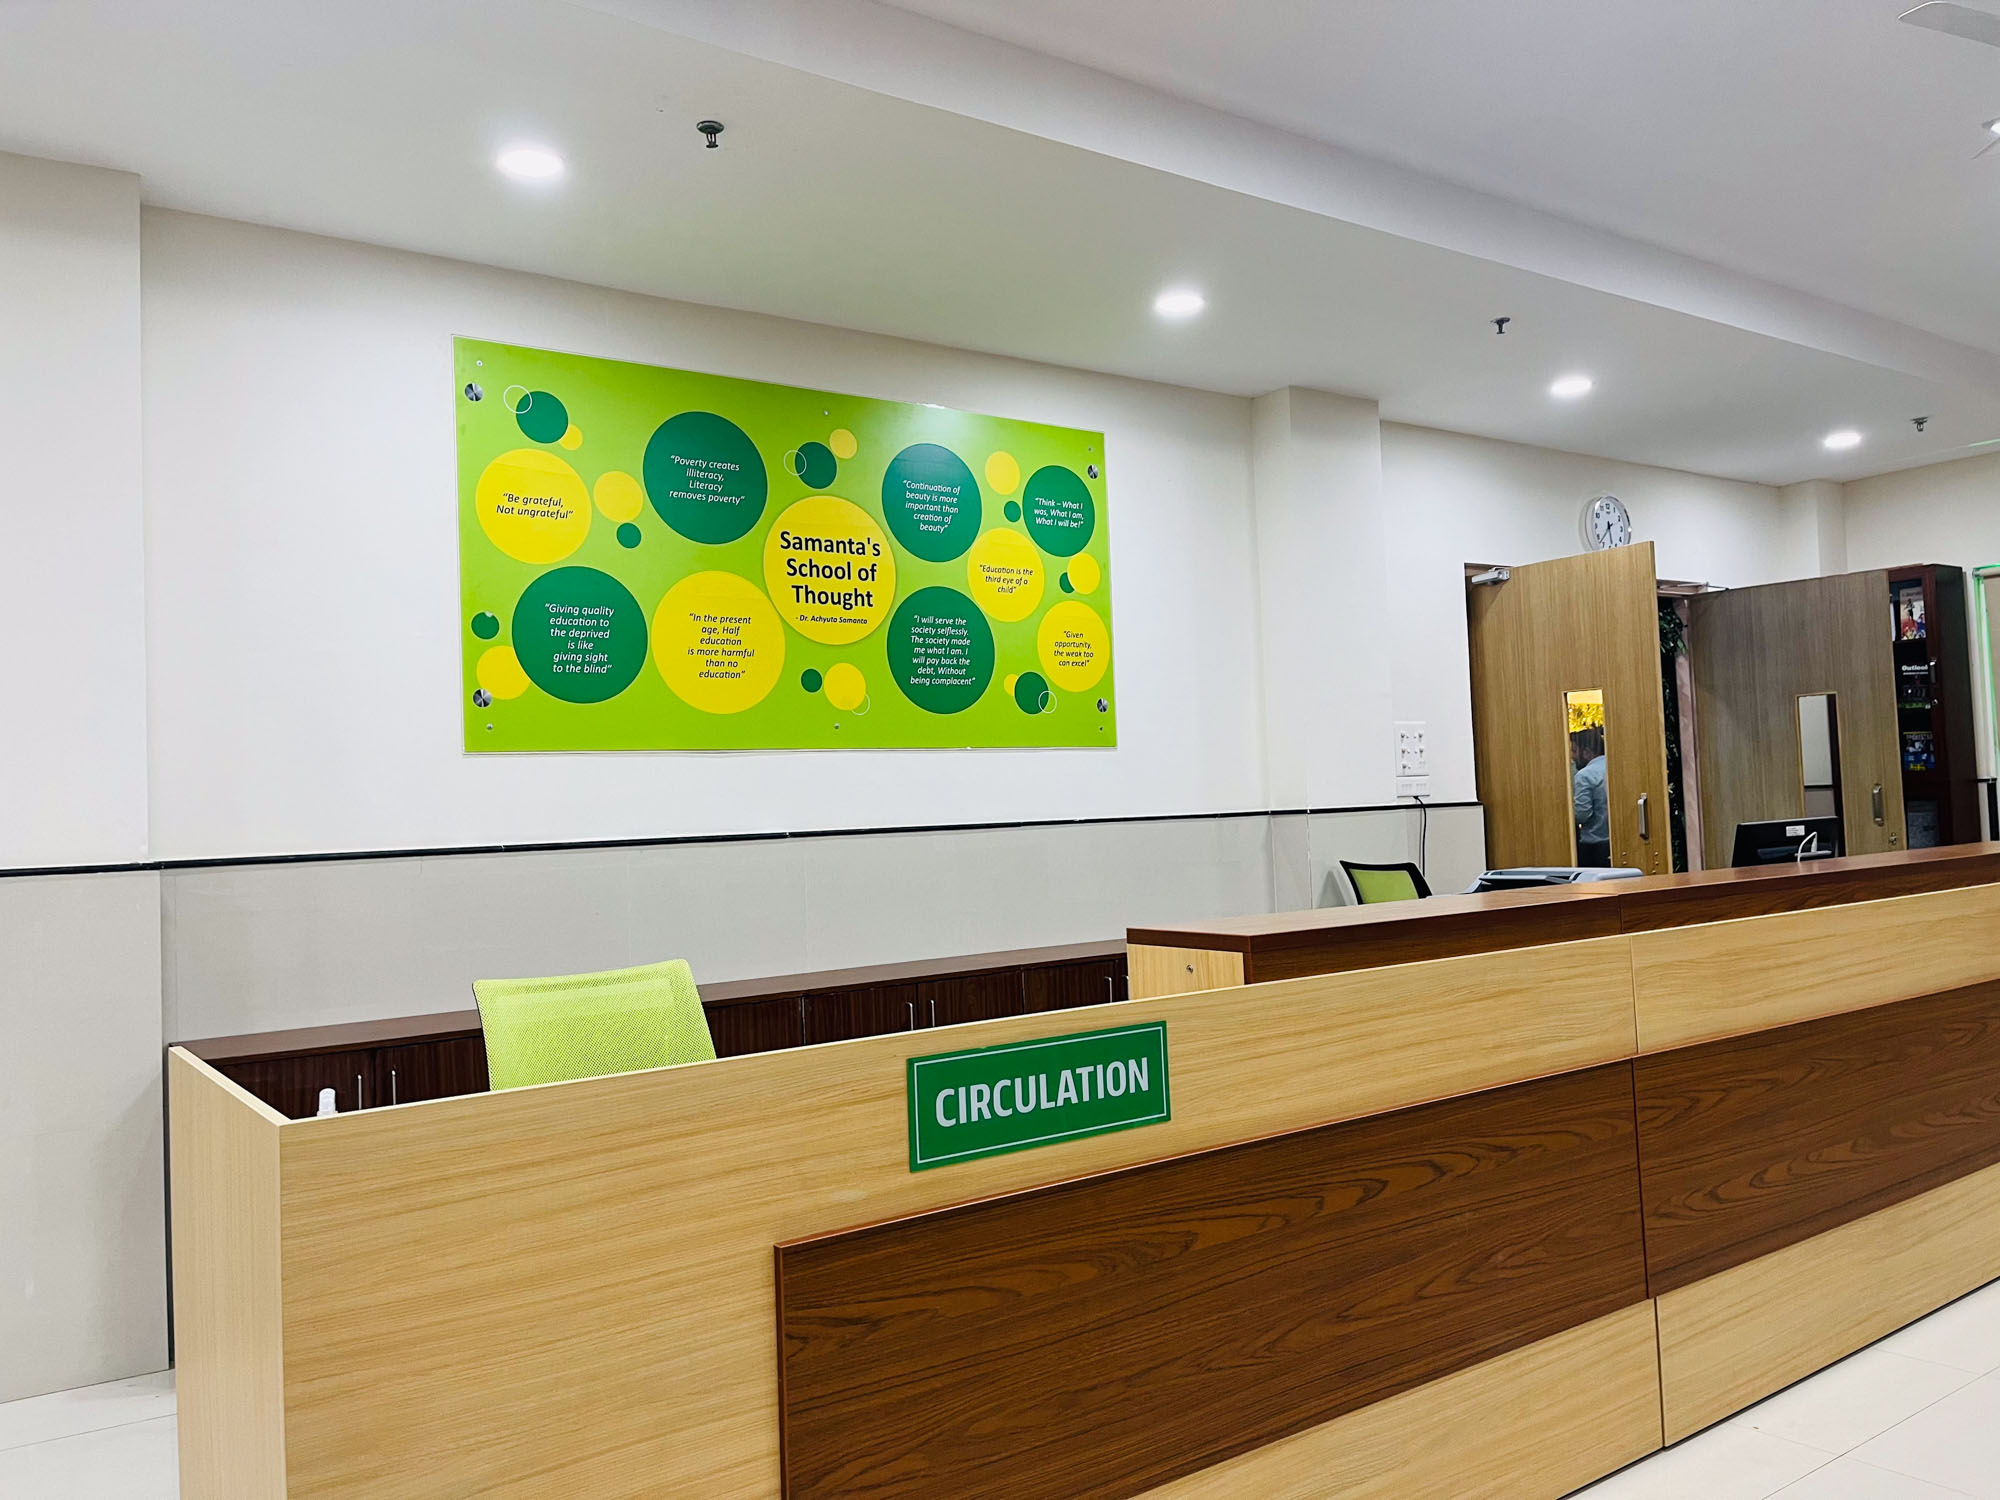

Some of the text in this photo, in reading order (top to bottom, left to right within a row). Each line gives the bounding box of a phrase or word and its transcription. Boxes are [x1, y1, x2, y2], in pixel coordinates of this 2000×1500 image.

[671, 455, 740, 471] “Poverty creates
[686, 469, 724, 481] illiteracy,
[689, 480, 722, 492] Literacy
[903, 480, 960, 495] “Continuation of
[503, 493, 564, 508] “Be grateful,
[670, 491, 745, 505] removes poverty”
[906, 491, 930, 502] beauty
[940, 496, 958, 504] more
[906, 501, 958, 513] important than
[1035, 498, 1056, 506] “Think
[1062, 501, 1079, 509] What
[496, 505, 573, 520] Not ungrateful”
[1034, 509, 1048, 517] was,
[1050, 509, 1067, 517] What
[913, 513, 952, 524] creation of
[1036, 517, 1053, 525] What
[920, 523, 948, 533] beauty”
[780, 531, 881, 556] Samanta's
[787, 558, 877, 581] School of
[980, 565, 1014, 574] “Education
[1016, 577, 1022, 586] of
[792, 585, 873, 610] Thought
[545, 604, 614, 617] “Giving quality
[550, 616, 609, 627] education to
[689, 613, 701, 621] “In
[704, 614, 717, 622] the
[914, 615, 920, 623] “I
[550, 628, 610, 639] the deprived
[702, 626, 740, 636] age, Half
[911, 626, 968, 636] society selflessly.
[568, 640, 594, 650] is like
[700, 637, 742, 645] education
[925, 637, 949, 646] society
[554, 652, 608, 663] giving sight
[722, 648, 754, 658] harmful
[553, 664, 612, 673] to the blind”
[706, 659, 725, 667] than
[699, 670, 746, 679] education”
[918, 667, 966, 675] debt, Without
[910, 676, 976, 686] being complacent”
[936, 1057, 1148, 1128] CIRCULATION
